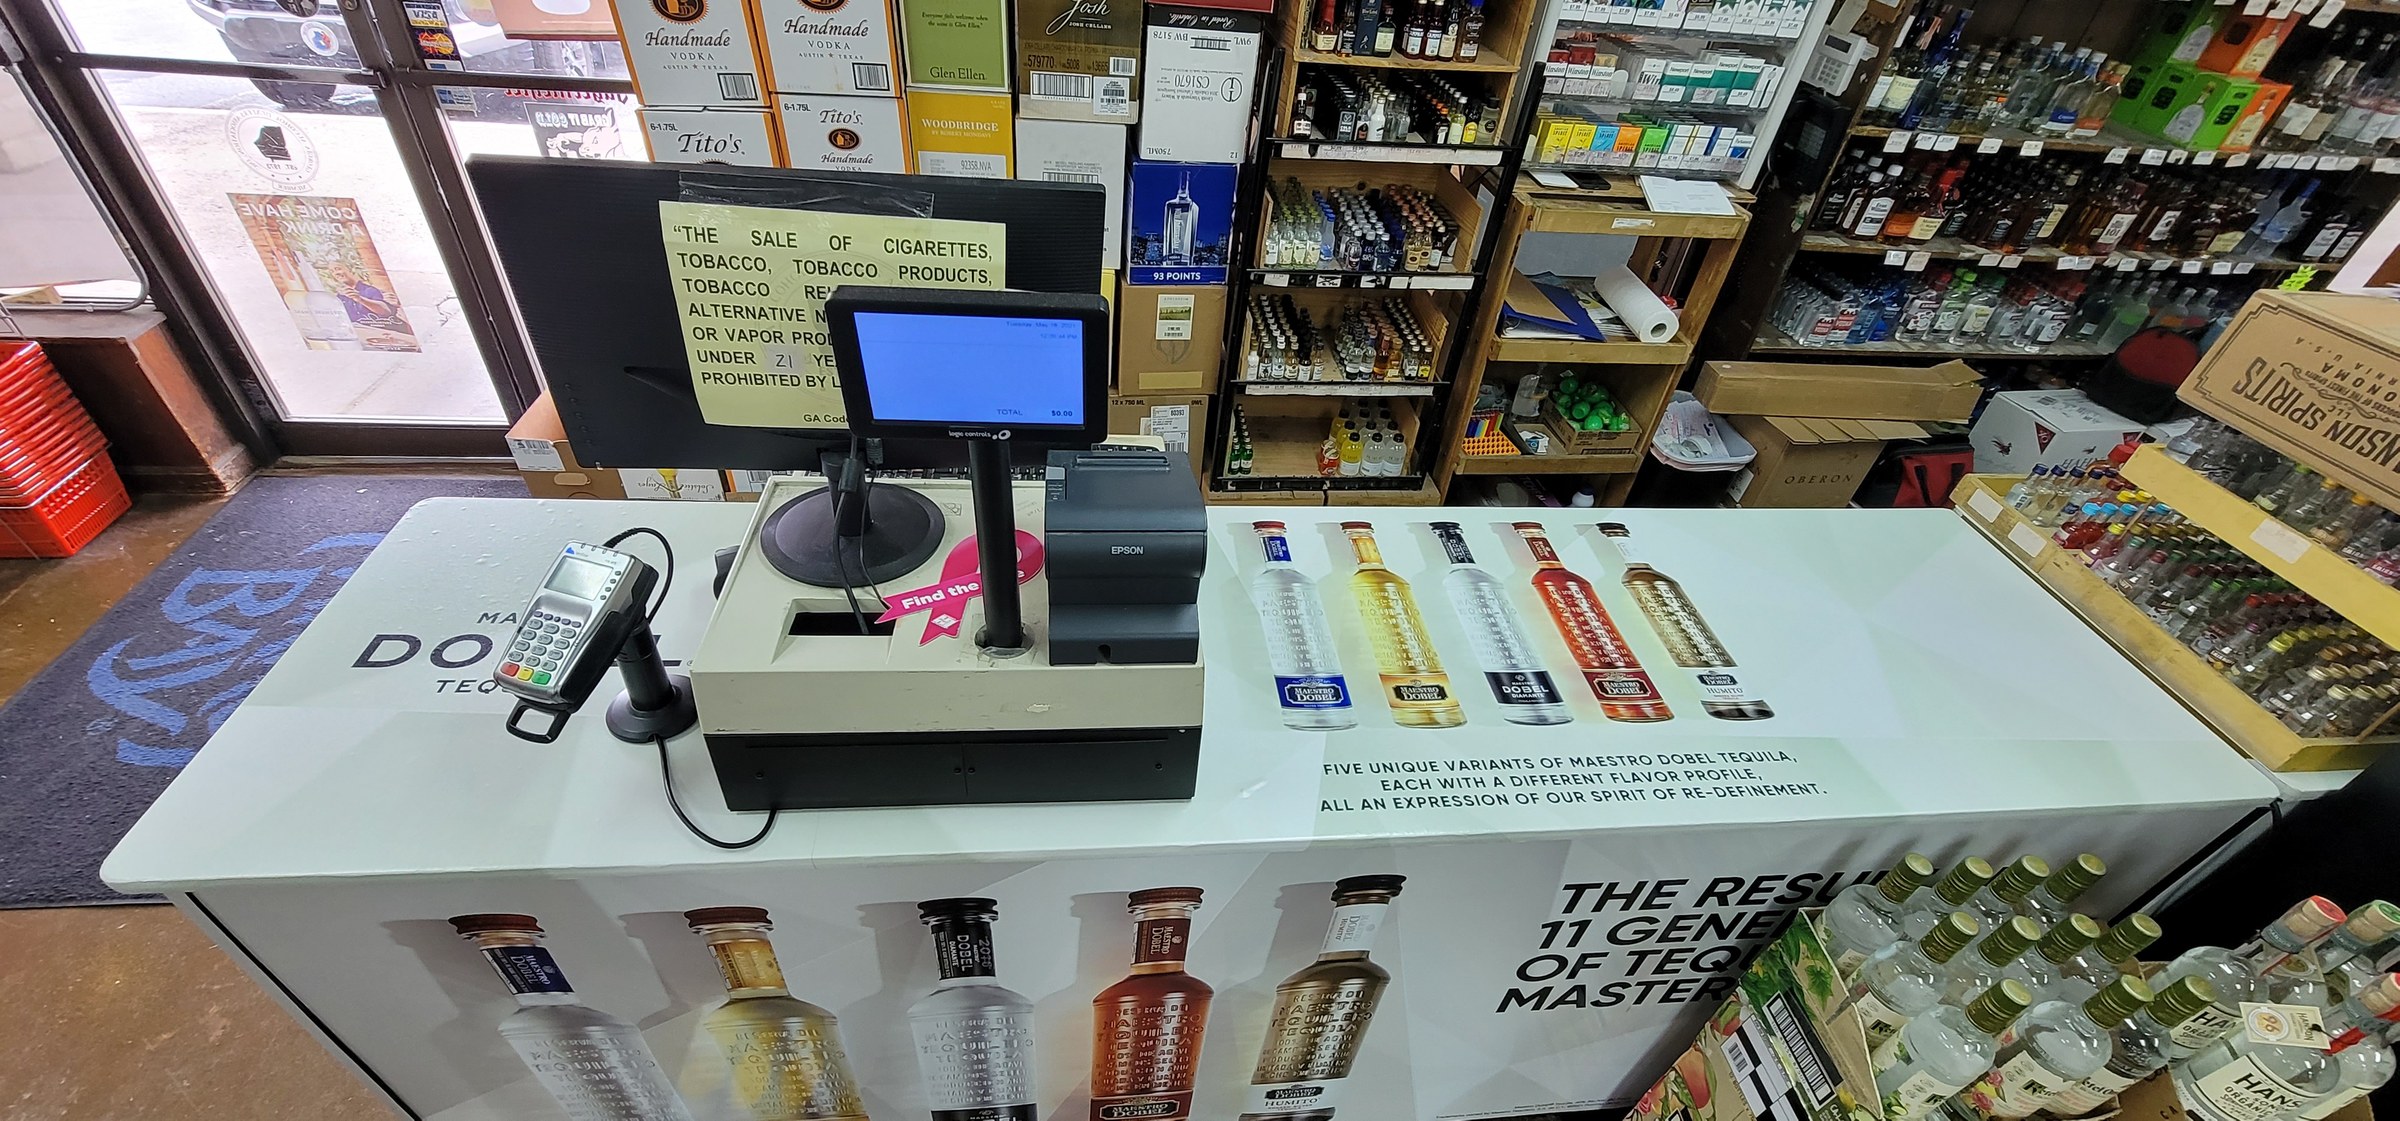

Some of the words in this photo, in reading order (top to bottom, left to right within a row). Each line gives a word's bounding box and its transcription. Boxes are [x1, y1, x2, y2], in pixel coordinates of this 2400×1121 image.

[1046, 0, 1110, 35] Josh
[784, 16, 870, 37] Handmade
[645, 28, 731, 47] Handmade
[1153, 31, 1172, 40] 5178
[1174, 32, 1188, 41] BW
[1234, 37, 1251, 46] 9WL
[808, 40, 851, 50] VODKA
[670, 52, 714, 61] VODKA
[930, 66, 956, 79] Glen
[958, 67, 986, 80] Ellen
[1568, 67, 1589, 76] Winston
[1591, 68, 1613, 77] Winston
[1174, 74, 1210, 88] CS1670
[784, 103, 811, 112] 6-1.75L
[650, 123, 678, 132] 6-1.75L
[922, 118, 999, 132] WOODBRIDGE
[821, 153, 873, 164] Handmade
[1146, 147, 1171, 156] 750ML
[751, 231, 798, 248] SALE
[829, 235, 852, 252] OF
[884, 238, 993, 262] CIGARETTES,
[677, 252, 773, 275] TOBACCO,
[793, 259, 878, 278] TOBACCO
[899, 265, 993, 287] PRODUCTS,
[1153, 272, 1164, 280] 93
[1166, 272, 1201, 281] POINTS
[682, 278, 770, 297] TOBACCO
[688, 303, 806, 323] ALTERNATIVE
[692, 326, 719, 342] OR
[724, 328, 786, 345] VAPOR
[697, 350, 757, 366] UNDER
[702, 373, 801, 389] PROHIBITED
[806, 375, 826, 389] BY
[2304, 369, 2329, 385] SPIRITS
[2231, 356, 2327, 431] SPIRITS
[2326, 381, 2350, 397] FINEST
[2348, 390, 2364, 403] THE
[803, 414, 821, 423] GA
[997, 408, 1023, 416] TOTAL
[2328, 404, 2351, 420] LLC
[1784, 474, 1854, 485] OBERON
[1111, 546, 1144, 555] EPSON
[901, 590, 946, 611] Find
[947, 581, 980, 597] the
[436, 680, 499, 694] TEQ
[1294, 686, 1334, 695] MAESTRO
[1400, 685, 1440, 694] MAESTRO
[1502, 684, 1549, 694] DOBEL
[1602, 681, 1641, 689] MAESTRO
[1605, 686, 1644, 694] DOBEL
[1297, 692, 1337, 702] DOBEL
[1402, 691, 1442, 701] DOBEL
[1323, 763, 1364, 775] FIVE
[1369, 761, 1440, 774] UNIQUE
[1443, 757, 1535, 772] VARIANTS
[1540, 757, 1564, 769] OF
[1568, 754, 1653, 768] MAESTRO
[1656, 752, 1716, 765] DOBEL
[1717, 751, 1798, 764] TEQUILA,
[1380, 779, 1432, 791] EACH
[1436, 777, 1487, 789] WITH
[1493, 776, 1506, 787] A
[1509, 773, 1603, 787] DIFFERENT
[1609, 771, 1682, 785] FLAVOR
[1684, 768, 1763, 782] PROFILE,
[1320, 800, 1355, 812] ALL
[1361, 798, 1387, 811] AN
[1394, 793, 1510, 809] EXPRESSION
[1514, 792, 1540, 805] OF
[1546, 791, 1587, 803] OUR
[1591, 789, 1648, 803] SPIRIT
[1652, 787, 1677, 800] OF
[1682, 783, 1828, 799] RE-DEFINEMENT.
[1561, 878, 1690, 915] THE
[1692, 871, 1890, 908] RESU
[1343, 915, 1361, 942] DOBEL
[1538, 920, 1593, 950] 11
[1150, 927, 1164, 955] DOBEL
[1161, 926, 1173, 954] MAESTRO
[957, 935, 973, 972] DOBEL
[510, 955, 537, 985] DOBEL
[523, 955, 551, 985] MAESTRO
[1515, 952, 1609, 984] OF
[2262, 1015, 2280, 1033] 96
